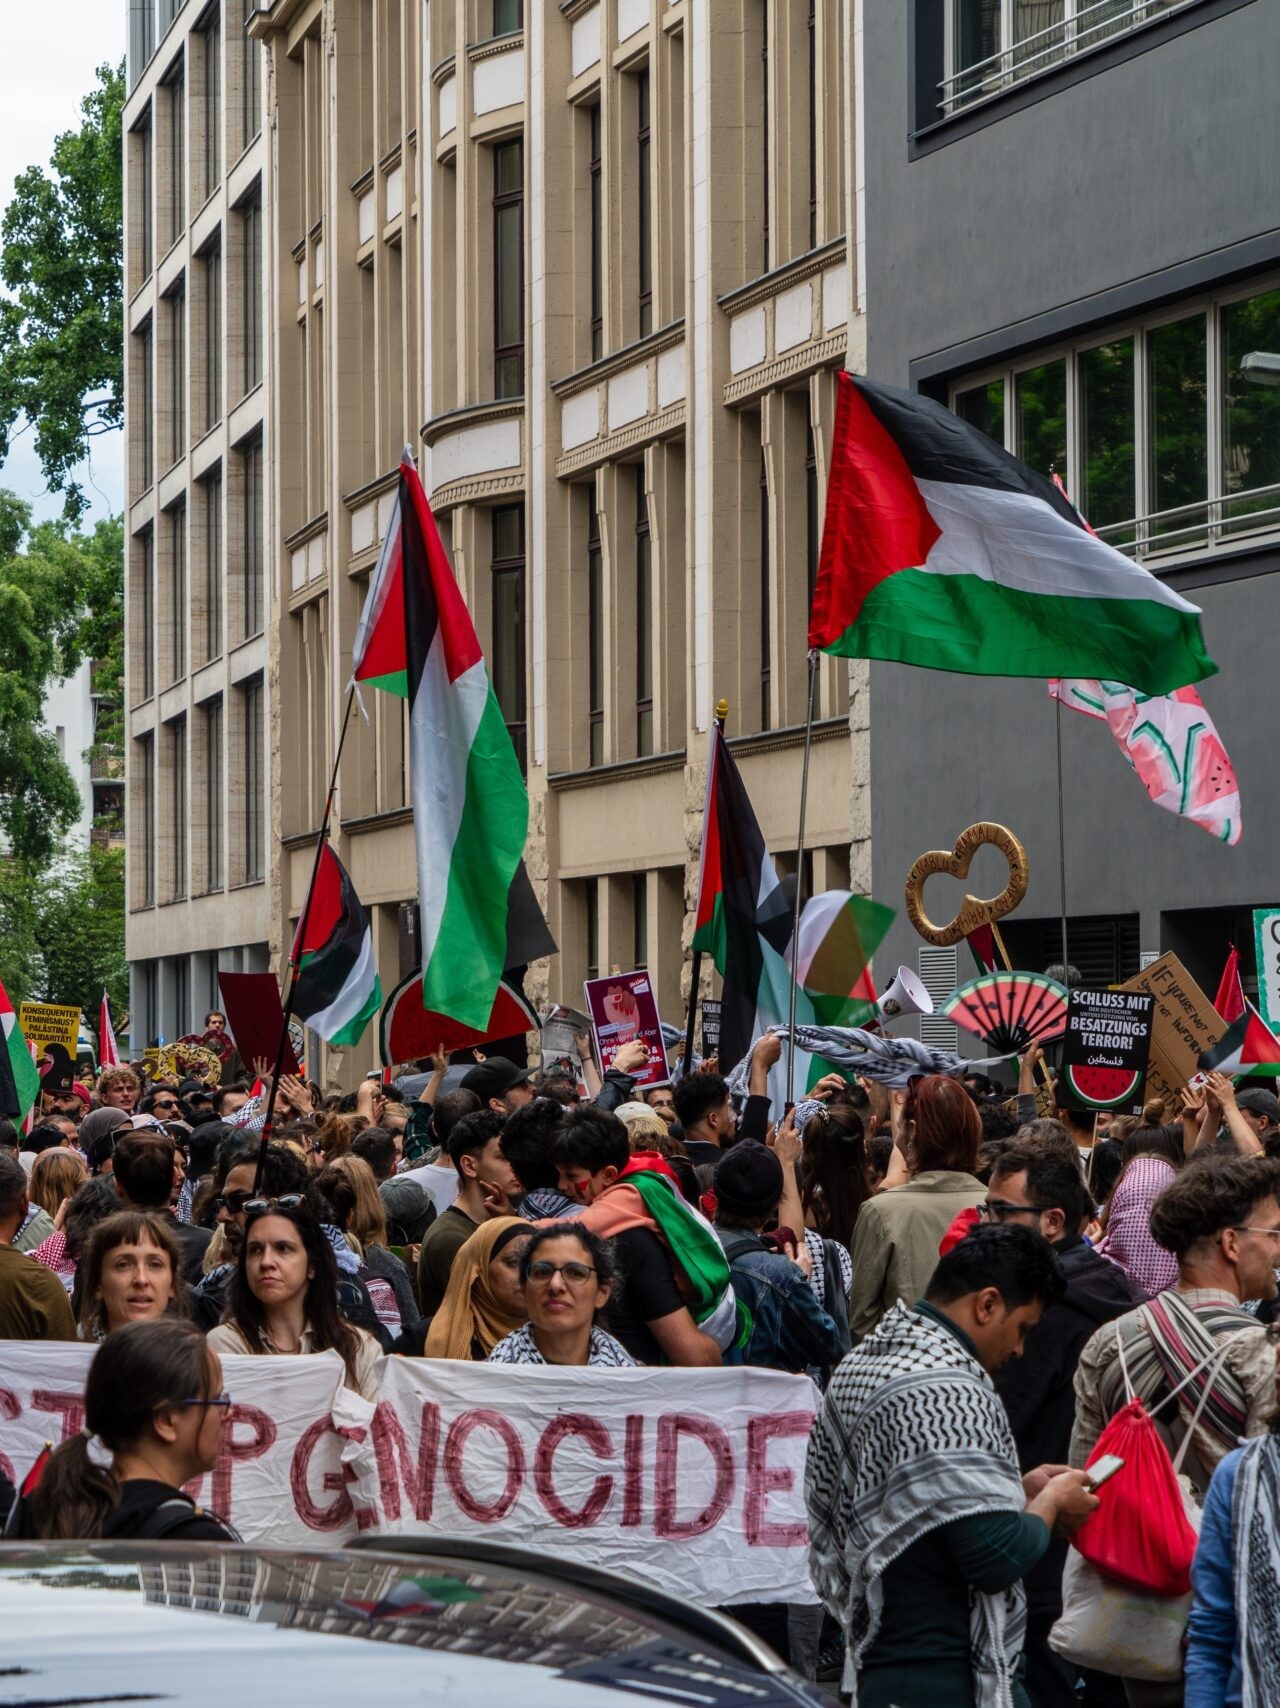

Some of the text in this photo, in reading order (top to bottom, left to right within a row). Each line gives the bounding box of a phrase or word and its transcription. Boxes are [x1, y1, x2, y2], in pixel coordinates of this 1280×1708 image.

[1072, 991, 1151, 1011] SCHLUSS MIT
[22, 1007, 78, 1018] KONSEQUENTER
[1100, 1007, 1132, 1015] DEUTSCHEN
[25, 1016, 74, 1026] FEMINISMUS?
[1070, 1017, 1147, 1036] BESATZUNGS
[29, 1024, 68, 1034] PALÄSTINA
[24, 1032, 72, 1044] SOLIDARITÄT!
[1082, 1032, 1133, 1050] TERROR!
[1088, 1053, 1123, 1066] فلسطين
